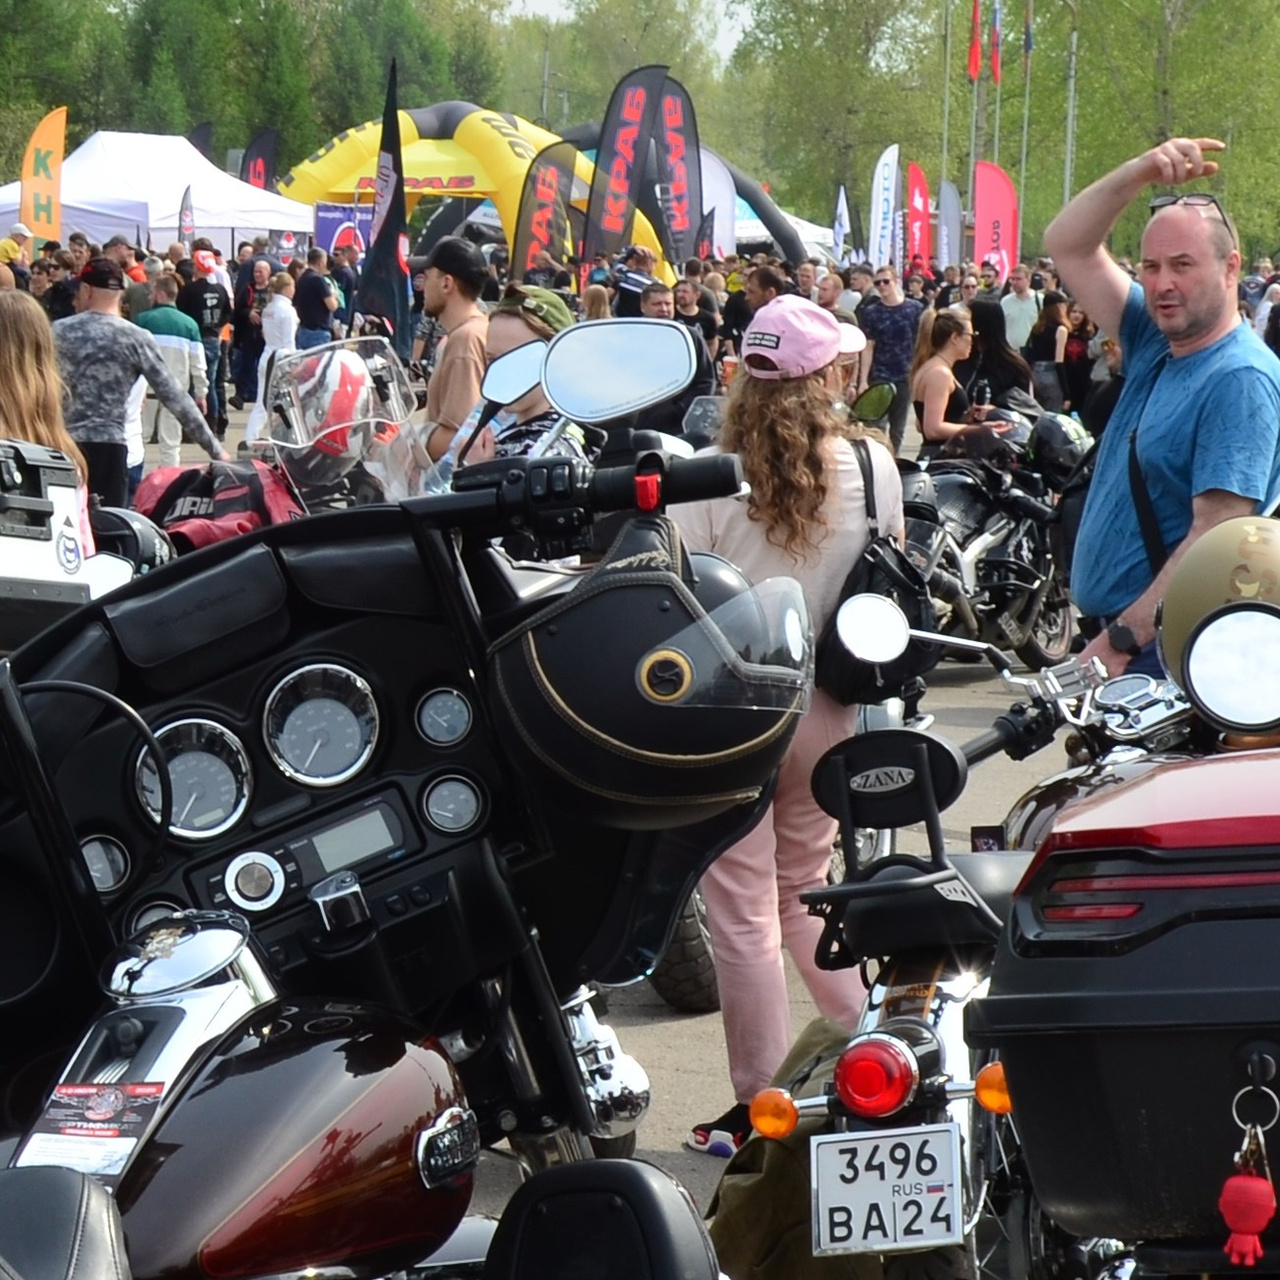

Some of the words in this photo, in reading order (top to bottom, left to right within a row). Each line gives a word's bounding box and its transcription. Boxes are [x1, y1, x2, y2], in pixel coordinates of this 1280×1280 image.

[526, 166, 558, 271] РАБ
[861, 770, 908, 788] ZANA
[838, 1138, 939, 1185] 3496
[891, 1181, 924, 1197] RUS
[902, 1196, 953, 1238] 24
